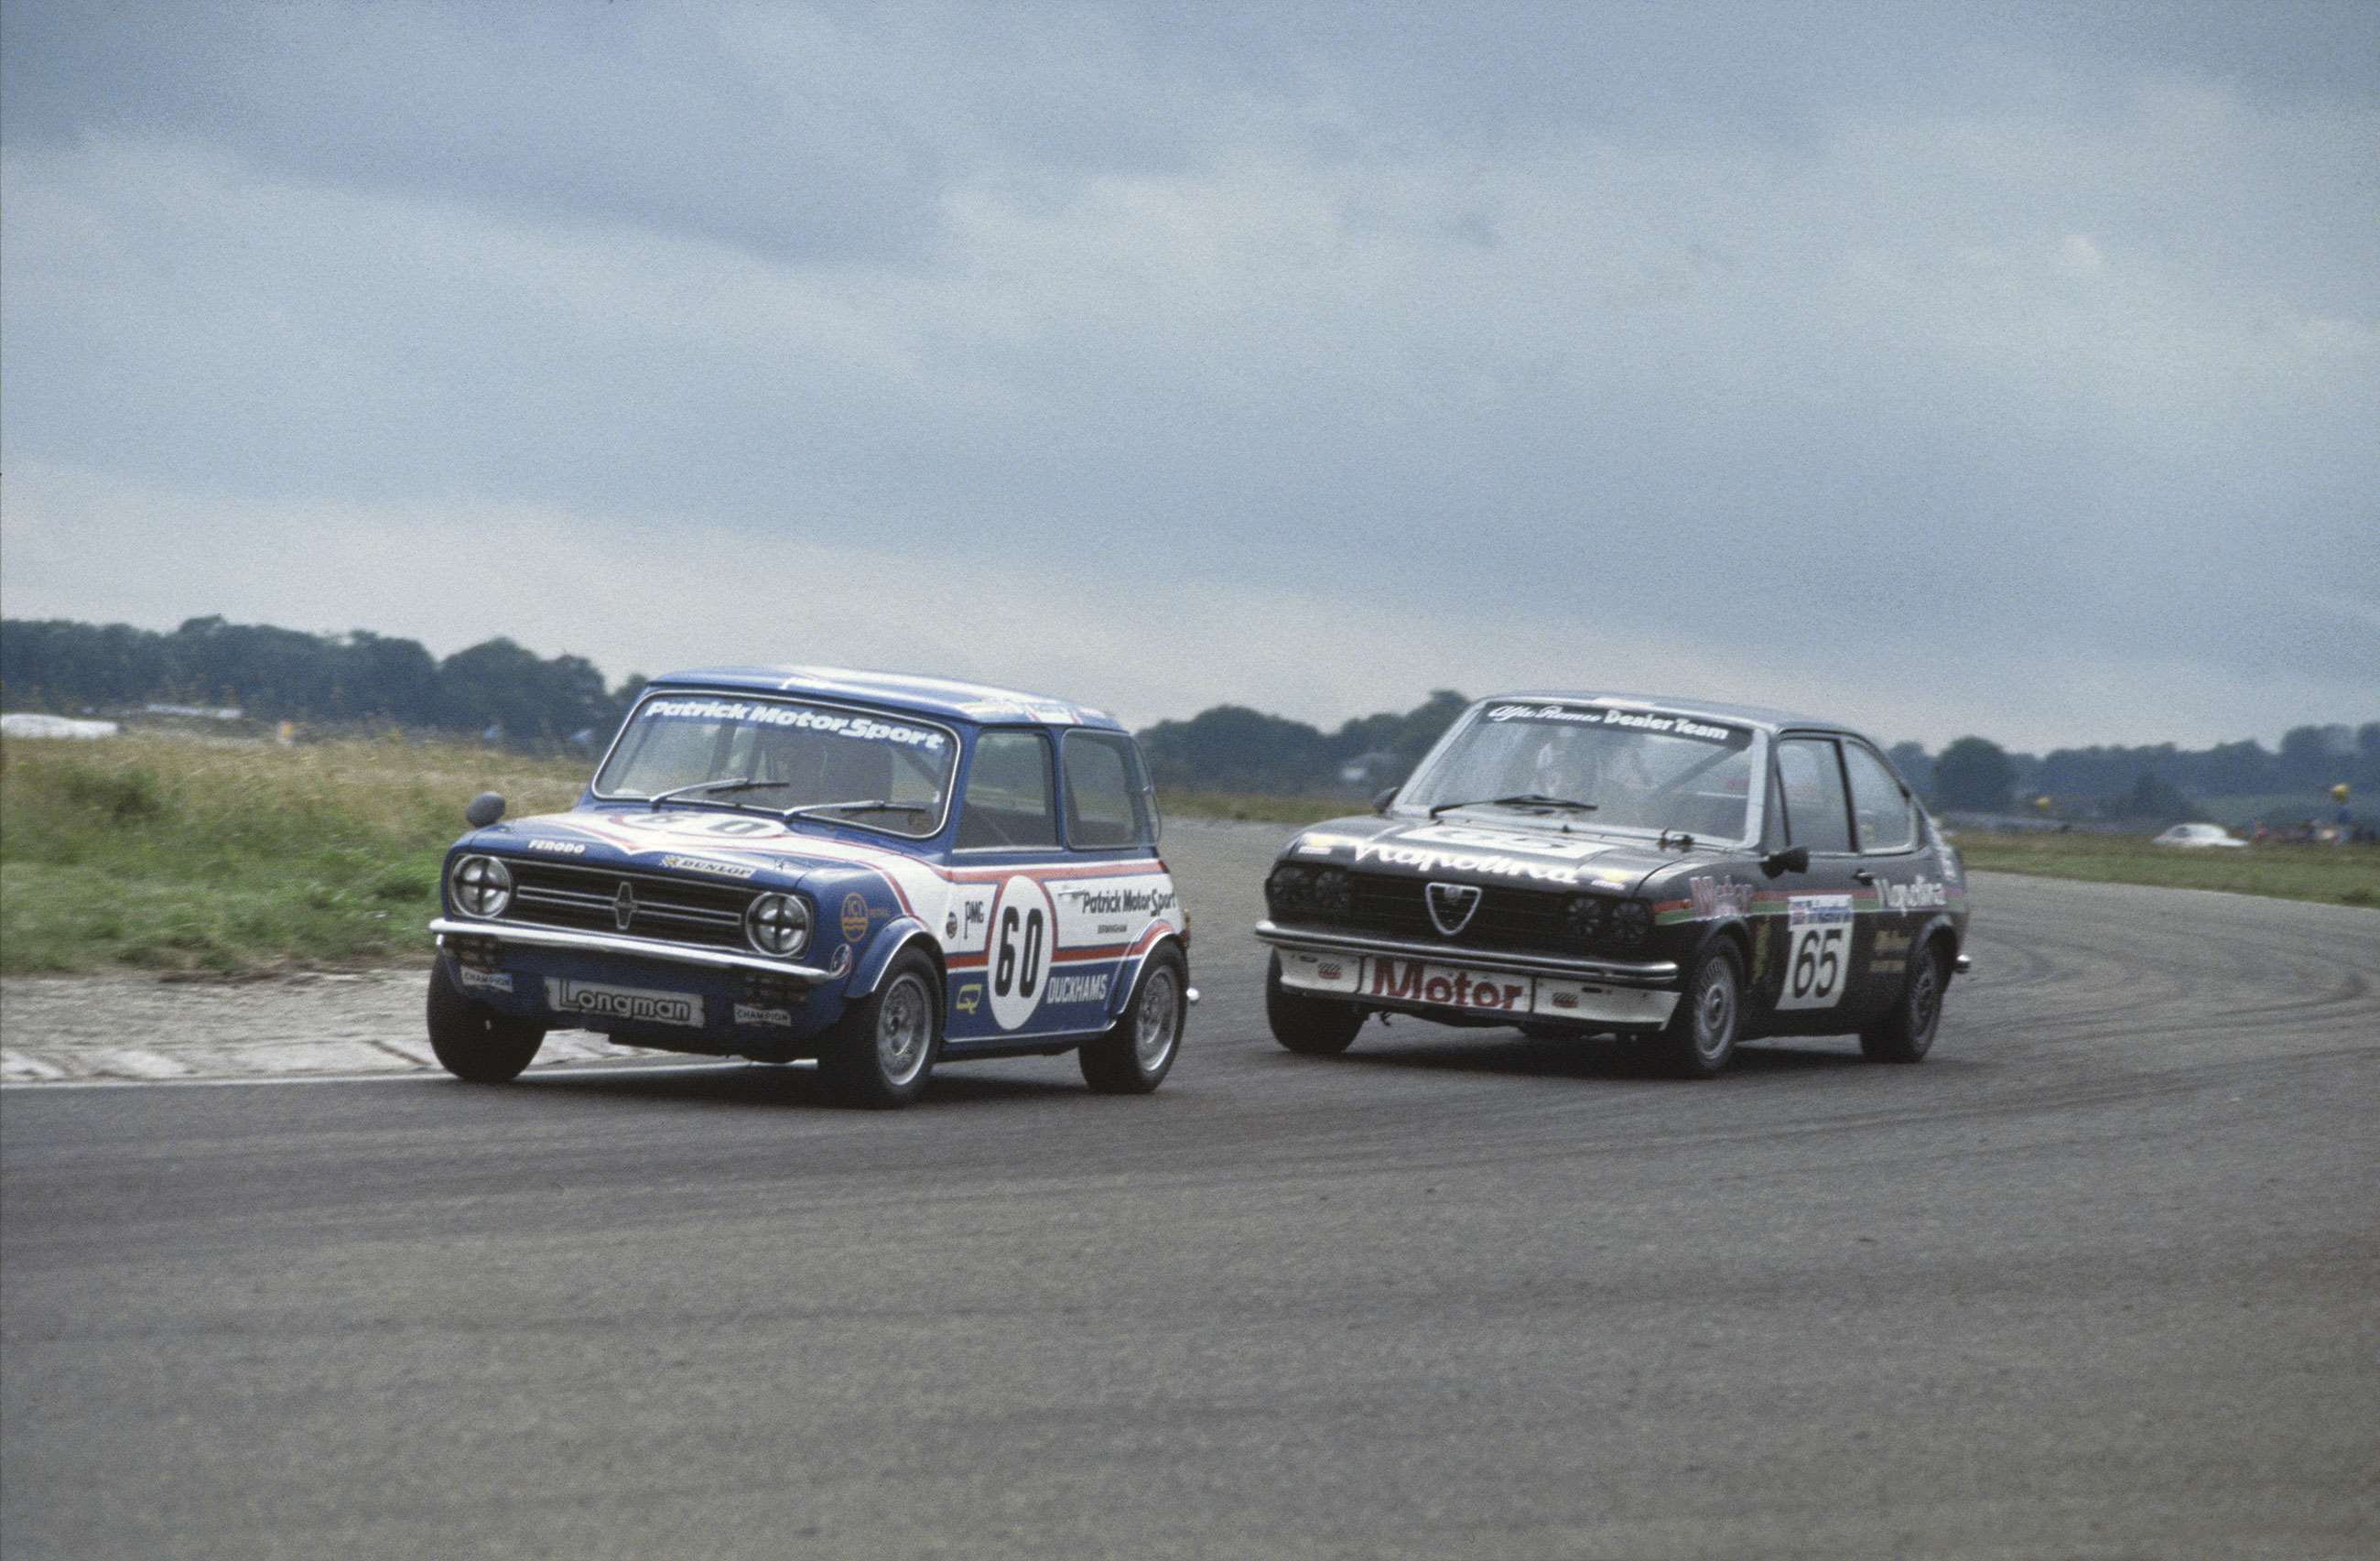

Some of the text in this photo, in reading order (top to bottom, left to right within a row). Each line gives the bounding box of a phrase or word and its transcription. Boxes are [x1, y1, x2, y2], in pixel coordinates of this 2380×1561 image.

[644, 700, 750, 719] Patrick
[1487, 704, 1536, 722] Alfa
[1603, 709, 1673, 731] Dealer
[1673, 717, 1730, 740] Team
[527, 839, 586, 854] FERODO
[680, 859, 752, 875] DUNLOP
[1082, 889, 1121, 914] Patrick
[994, 905, 1044, 999] 60
[1793, 928, 1843, 999] 65
[463, 972, 511, 987] CHAMPION
[1046, 973, 1109, 1003] DUCKHAMS
[1370, 959, 1523, 1011] Motor
[557, 978, 691, 1024] Longman
[735, 1009, 789, 1024] CHAMPION
